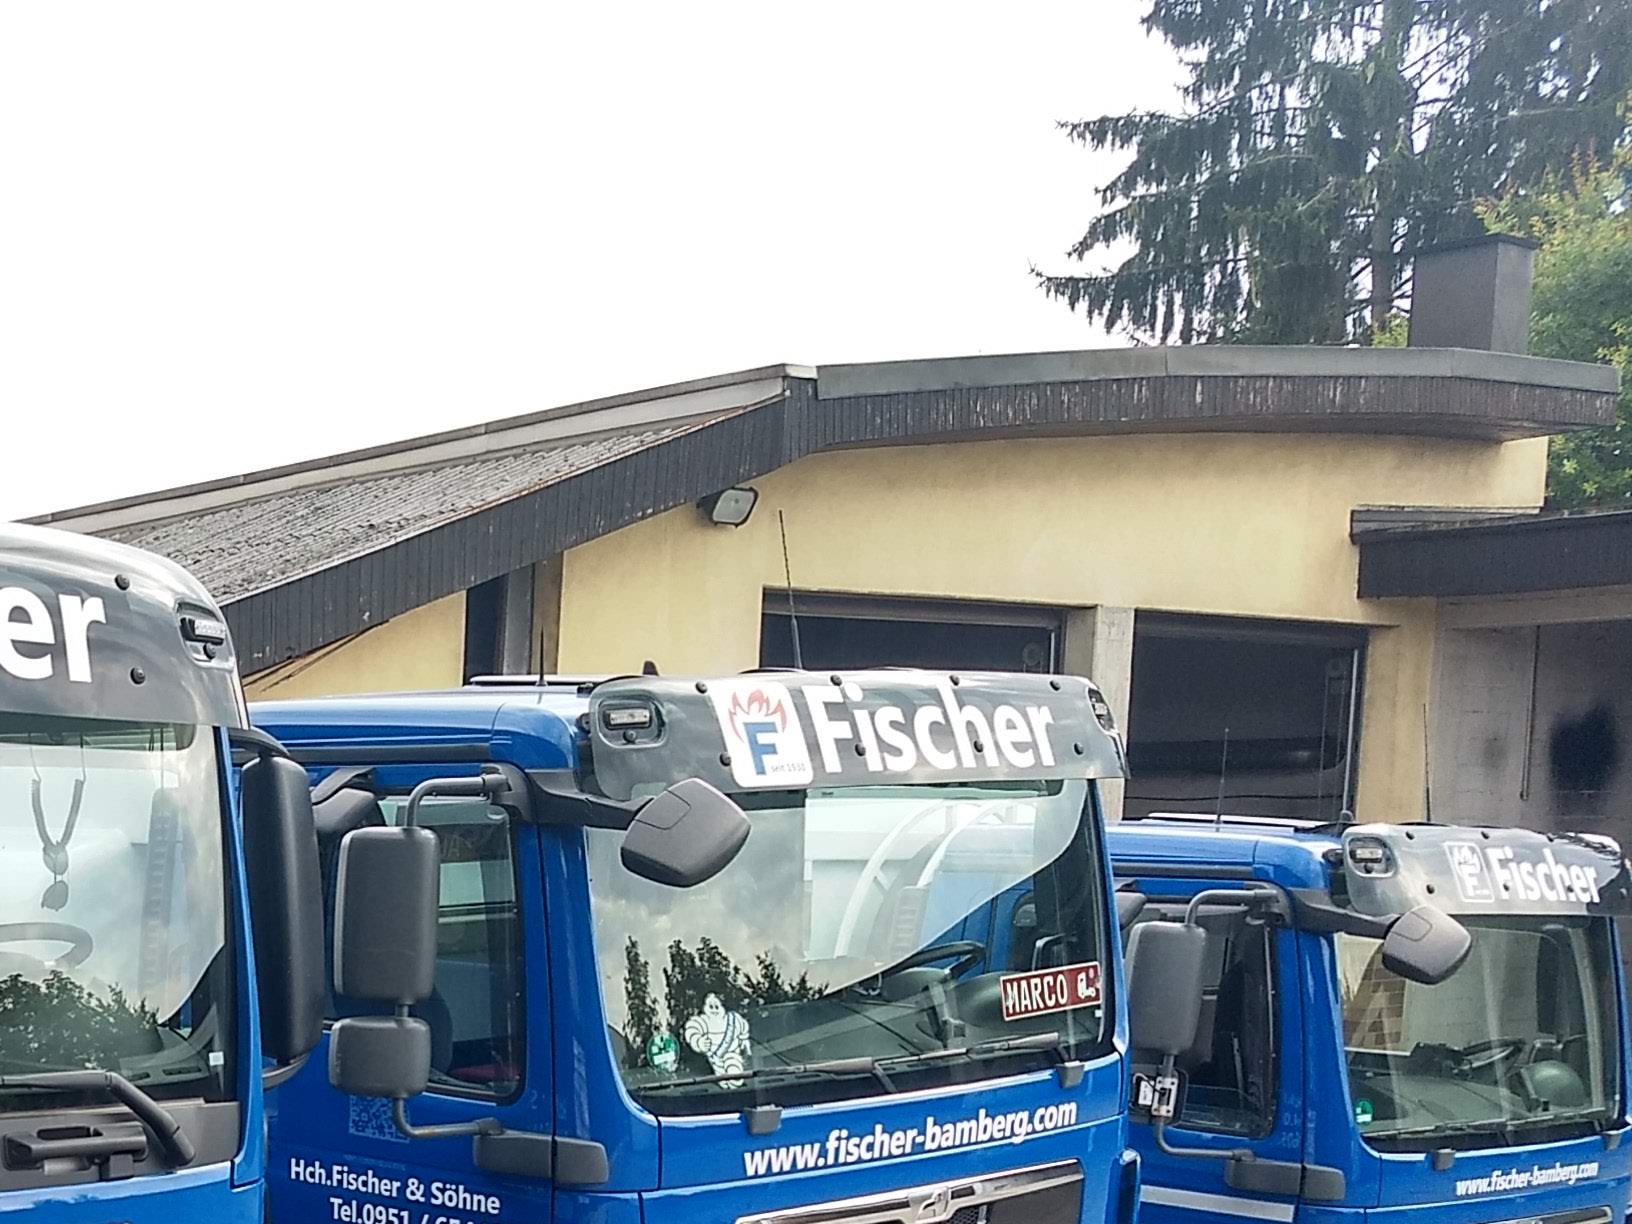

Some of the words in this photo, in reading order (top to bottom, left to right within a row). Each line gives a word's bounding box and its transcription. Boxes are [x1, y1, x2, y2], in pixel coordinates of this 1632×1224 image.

[800, 681, 1056, 774] Fischer
[1484, 845, 1601, 903] Fischer
[1005, 973, 1069, 1014] MARCO
[743, 1100, 1078, 1177] www.fischer-bamberg.com
[290, 1157, 401, 1198] Hch.Fischer
[405, 1177, 426, 1203] &
[430, 1181, 501, 1215] Söhne
[1455, 1161, 1600, 1197] www.fischer-bamberg.com
